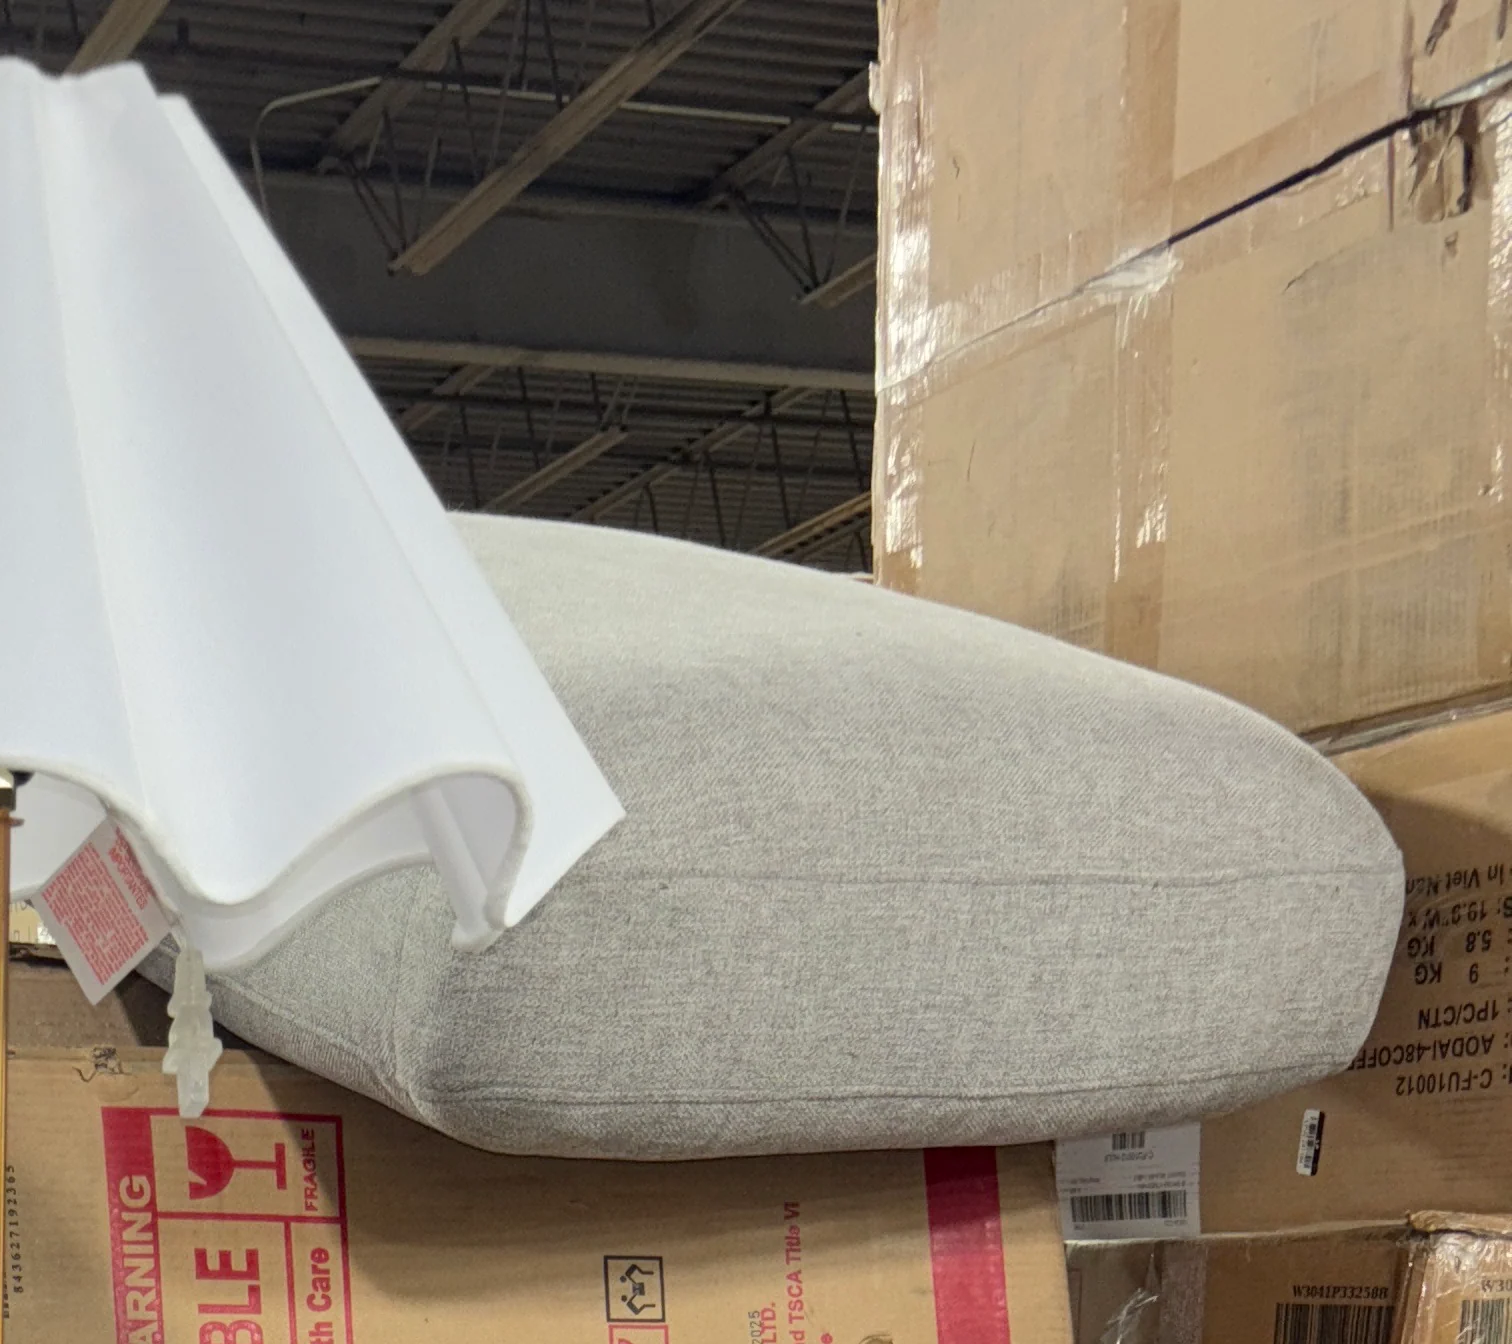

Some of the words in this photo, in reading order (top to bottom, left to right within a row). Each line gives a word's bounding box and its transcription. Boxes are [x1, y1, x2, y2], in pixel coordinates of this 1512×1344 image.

[1447, 868, 1481, 890] Viet
[1408, 935, 1436, 958] KG
[1465, 930, 1492, 953] 5.8
[1414, 961, 1442, 985] KG
[1469, 963, 1479, 984] 9
[1417, 999, 1500, 1029] 1PC/CTN
[1395, 1067, 1493, 1097] C-FU10012
[301, 1127, 319, 1212] FRAGILE
[785, 1225, 802, 1266] Title
[307, 1246, 334, 1313] Care
[786, 1269, 806, 1325] TSCA
[759, 1302, 777, 1344] LTD.
